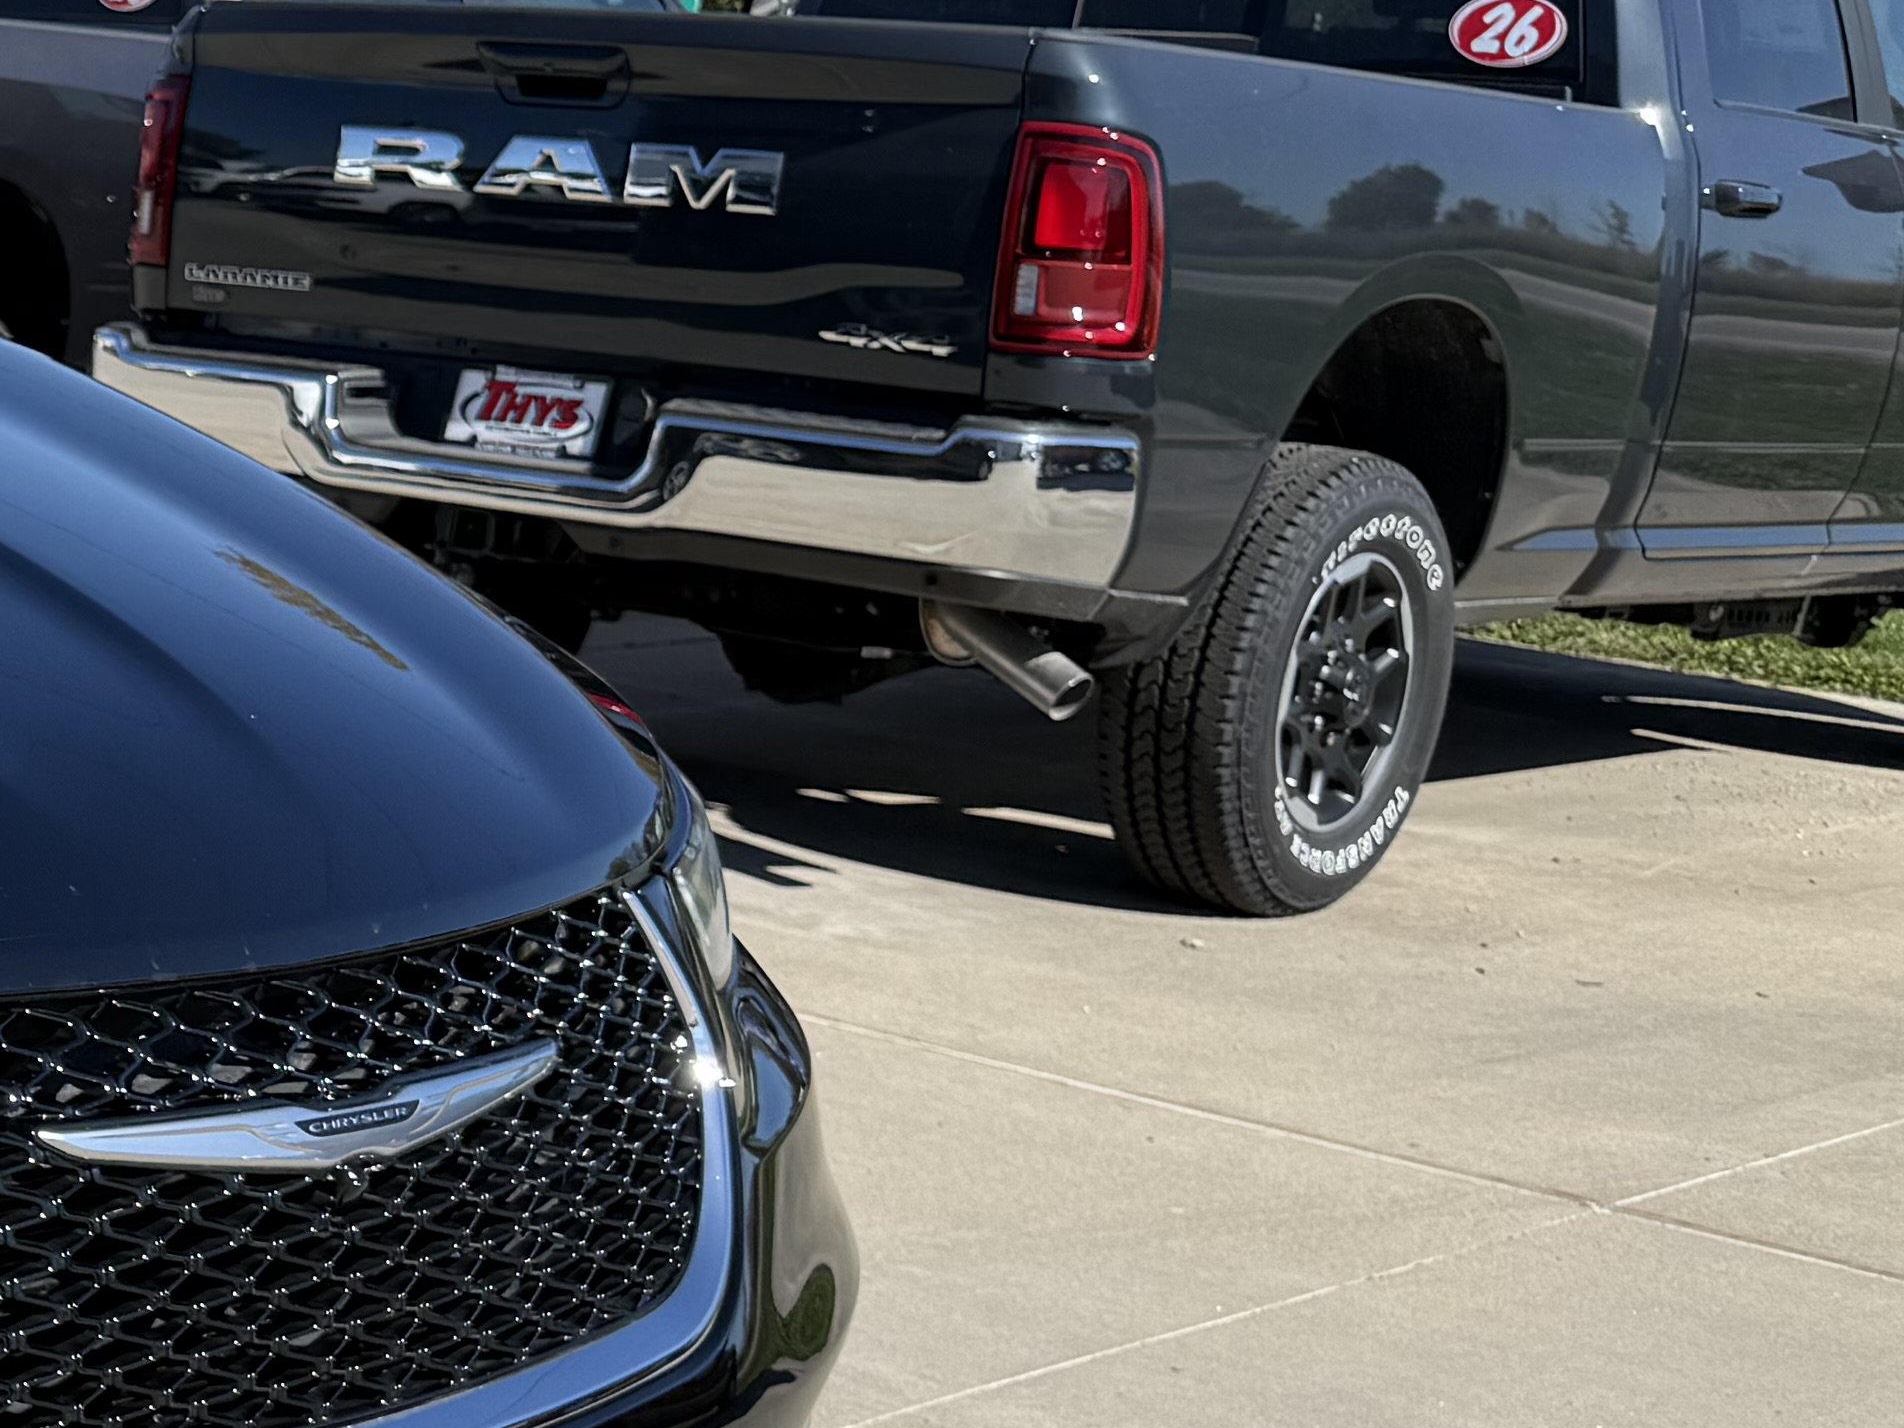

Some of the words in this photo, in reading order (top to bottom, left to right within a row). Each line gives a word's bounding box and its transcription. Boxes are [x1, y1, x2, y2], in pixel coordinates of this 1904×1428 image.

[1470, 1, 1545, 58] 26
[333, 123, 786, 216] RAM
[184, 262, 313, 292] LARAMIE
[308, 1106, 408, 1134] CHRYSLER
